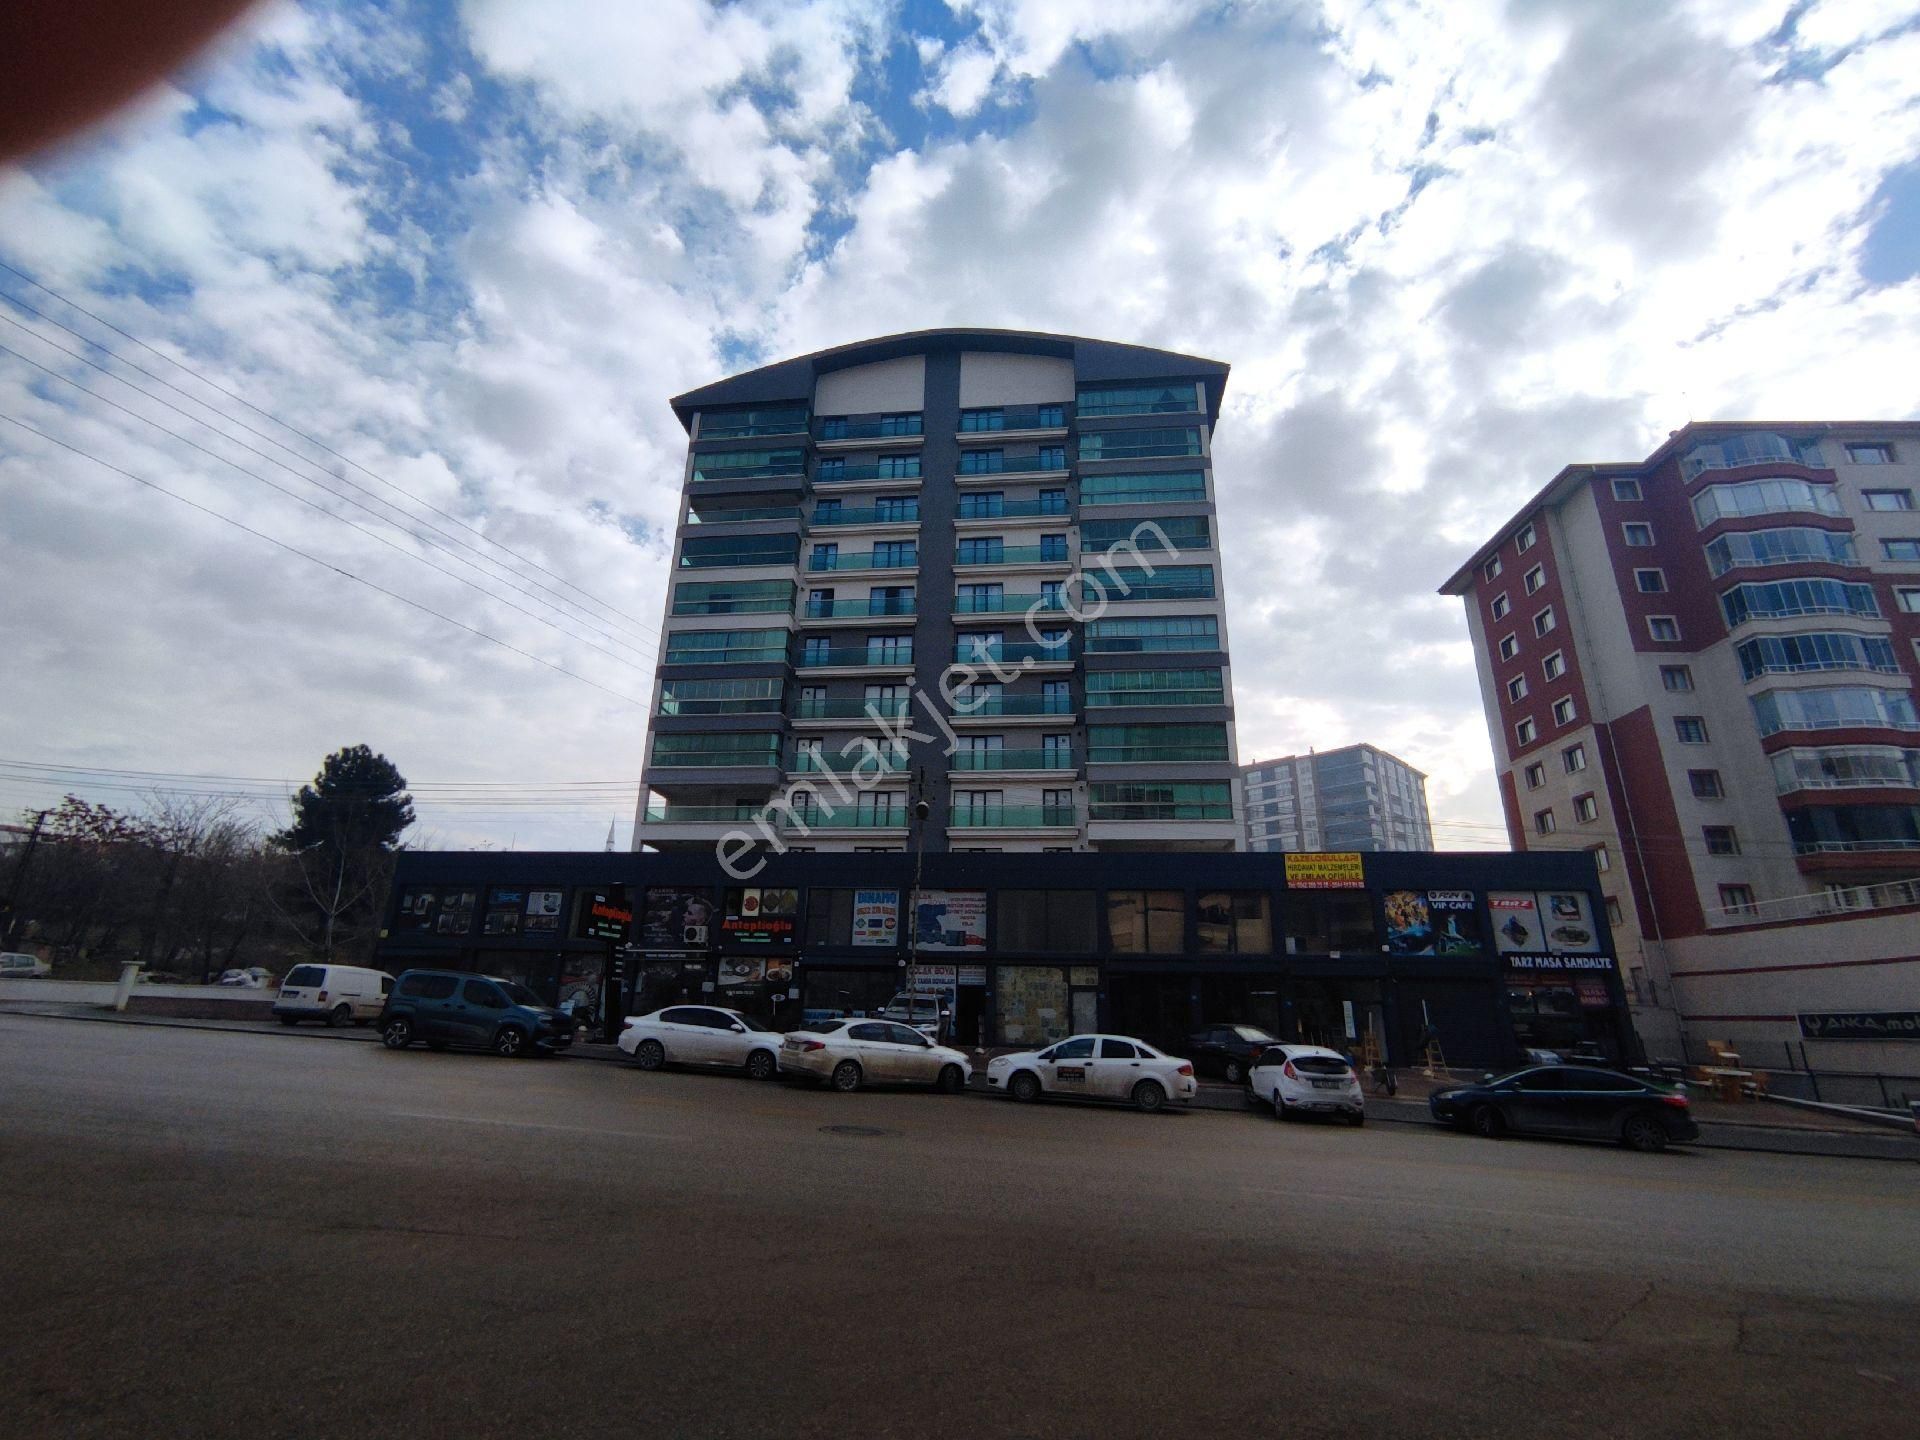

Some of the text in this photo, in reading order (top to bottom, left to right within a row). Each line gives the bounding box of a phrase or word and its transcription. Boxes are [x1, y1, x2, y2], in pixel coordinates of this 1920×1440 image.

[721, 920, 792, 933] Anteplioğlu
[1509, 957, 1612, 968] TARZ MASA SANDALYE
